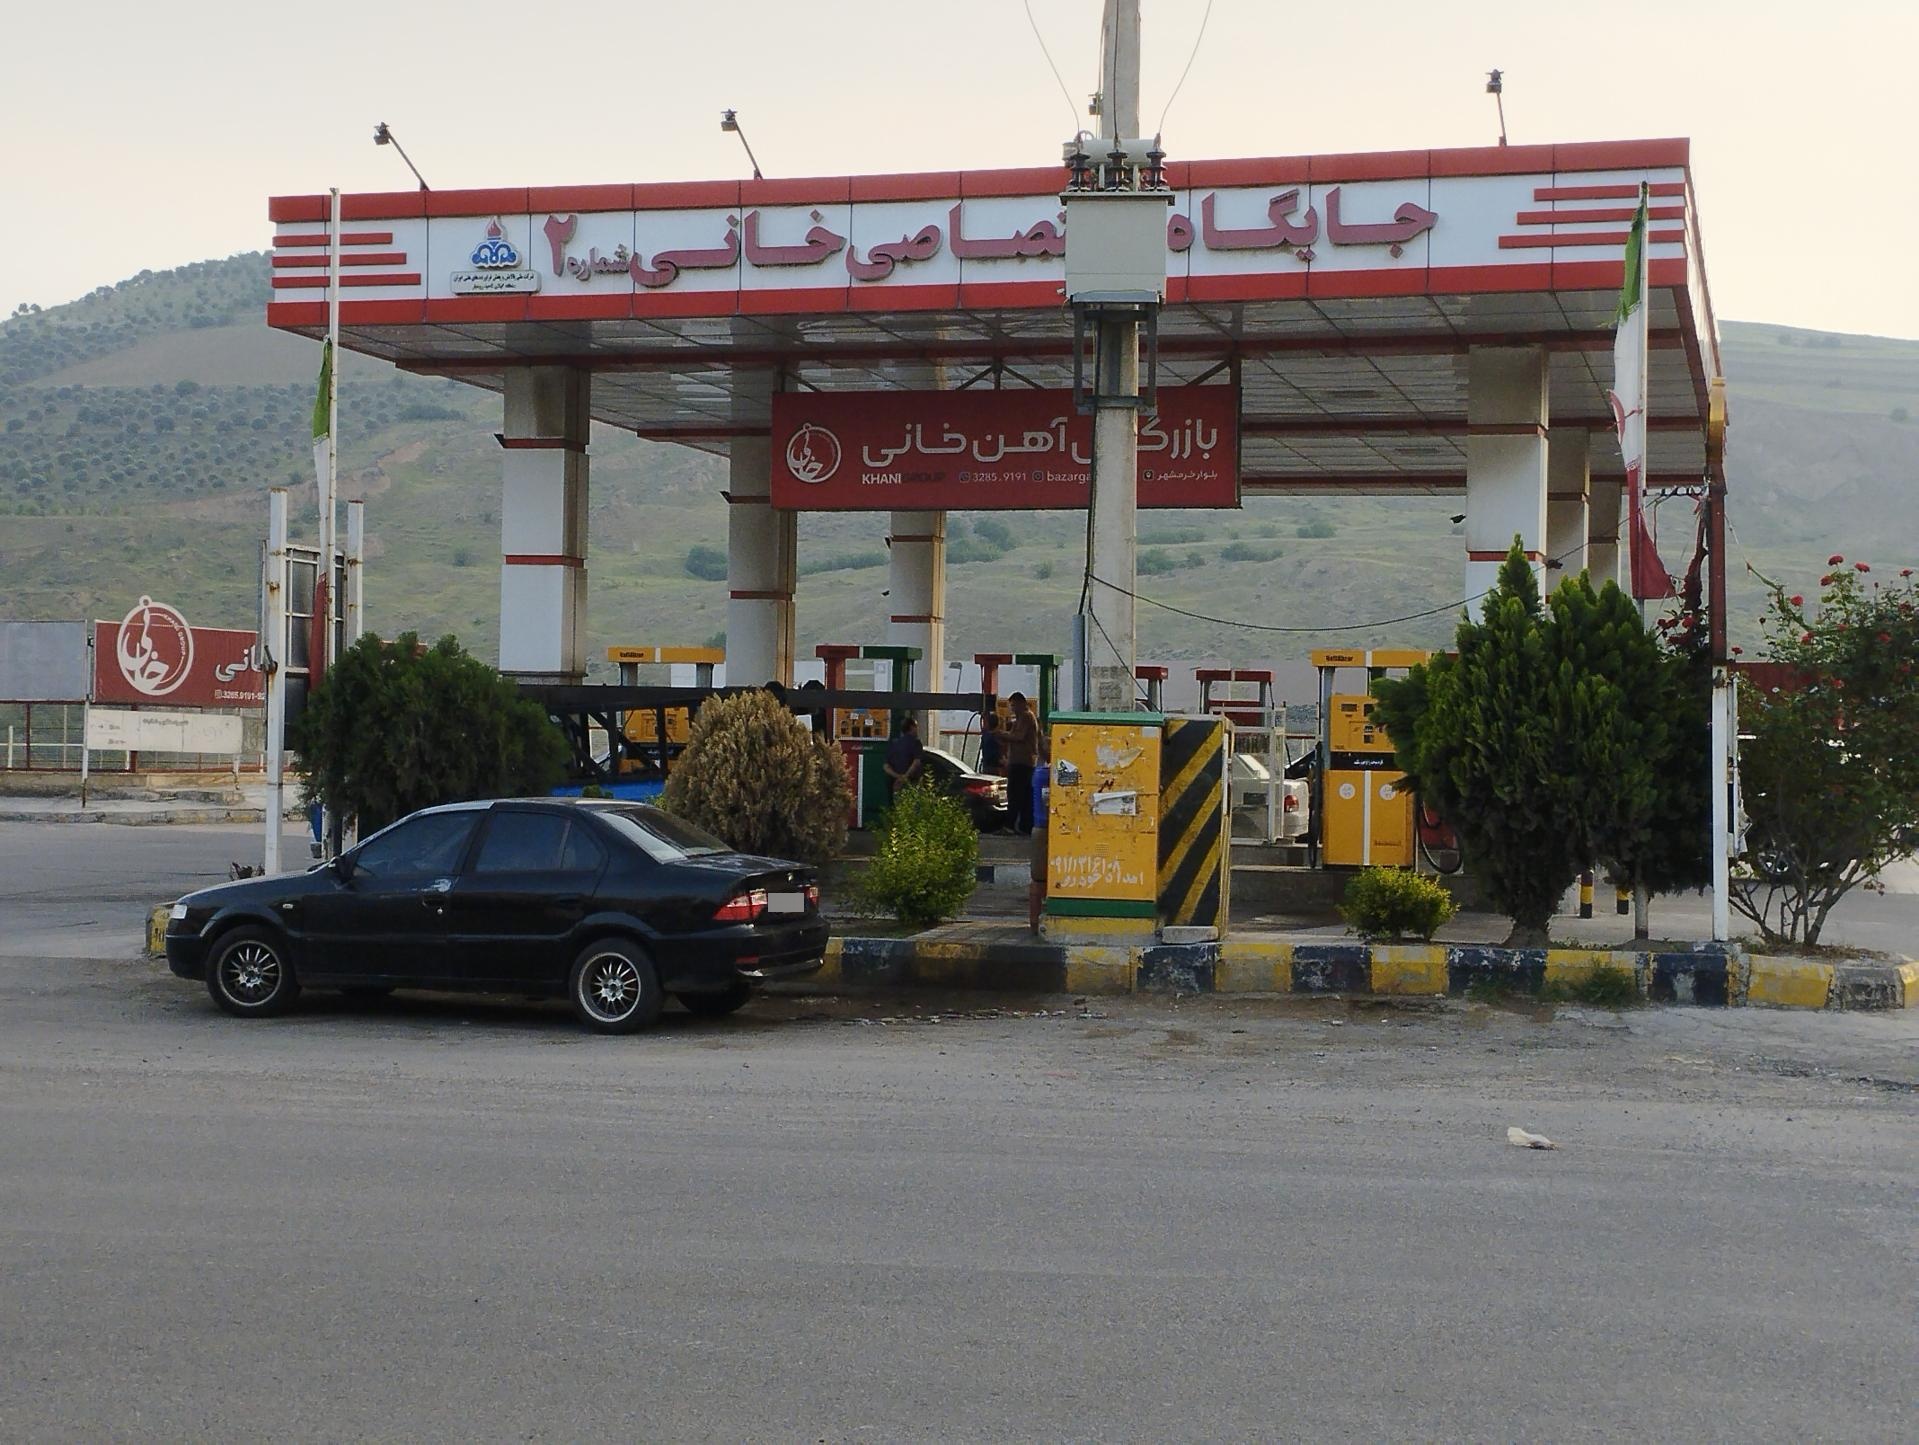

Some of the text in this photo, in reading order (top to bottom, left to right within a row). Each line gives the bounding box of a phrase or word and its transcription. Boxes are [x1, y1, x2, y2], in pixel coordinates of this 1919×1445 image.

[544, 184, 1438, 288] جایگاه صاصی خانی شماره ۲
[862, 422, 968, 468] خانی
[972, 416, 1068, 463] آهن
[861, 473, 902, 485] KHANI
[215, 644, 262, 682] انی
